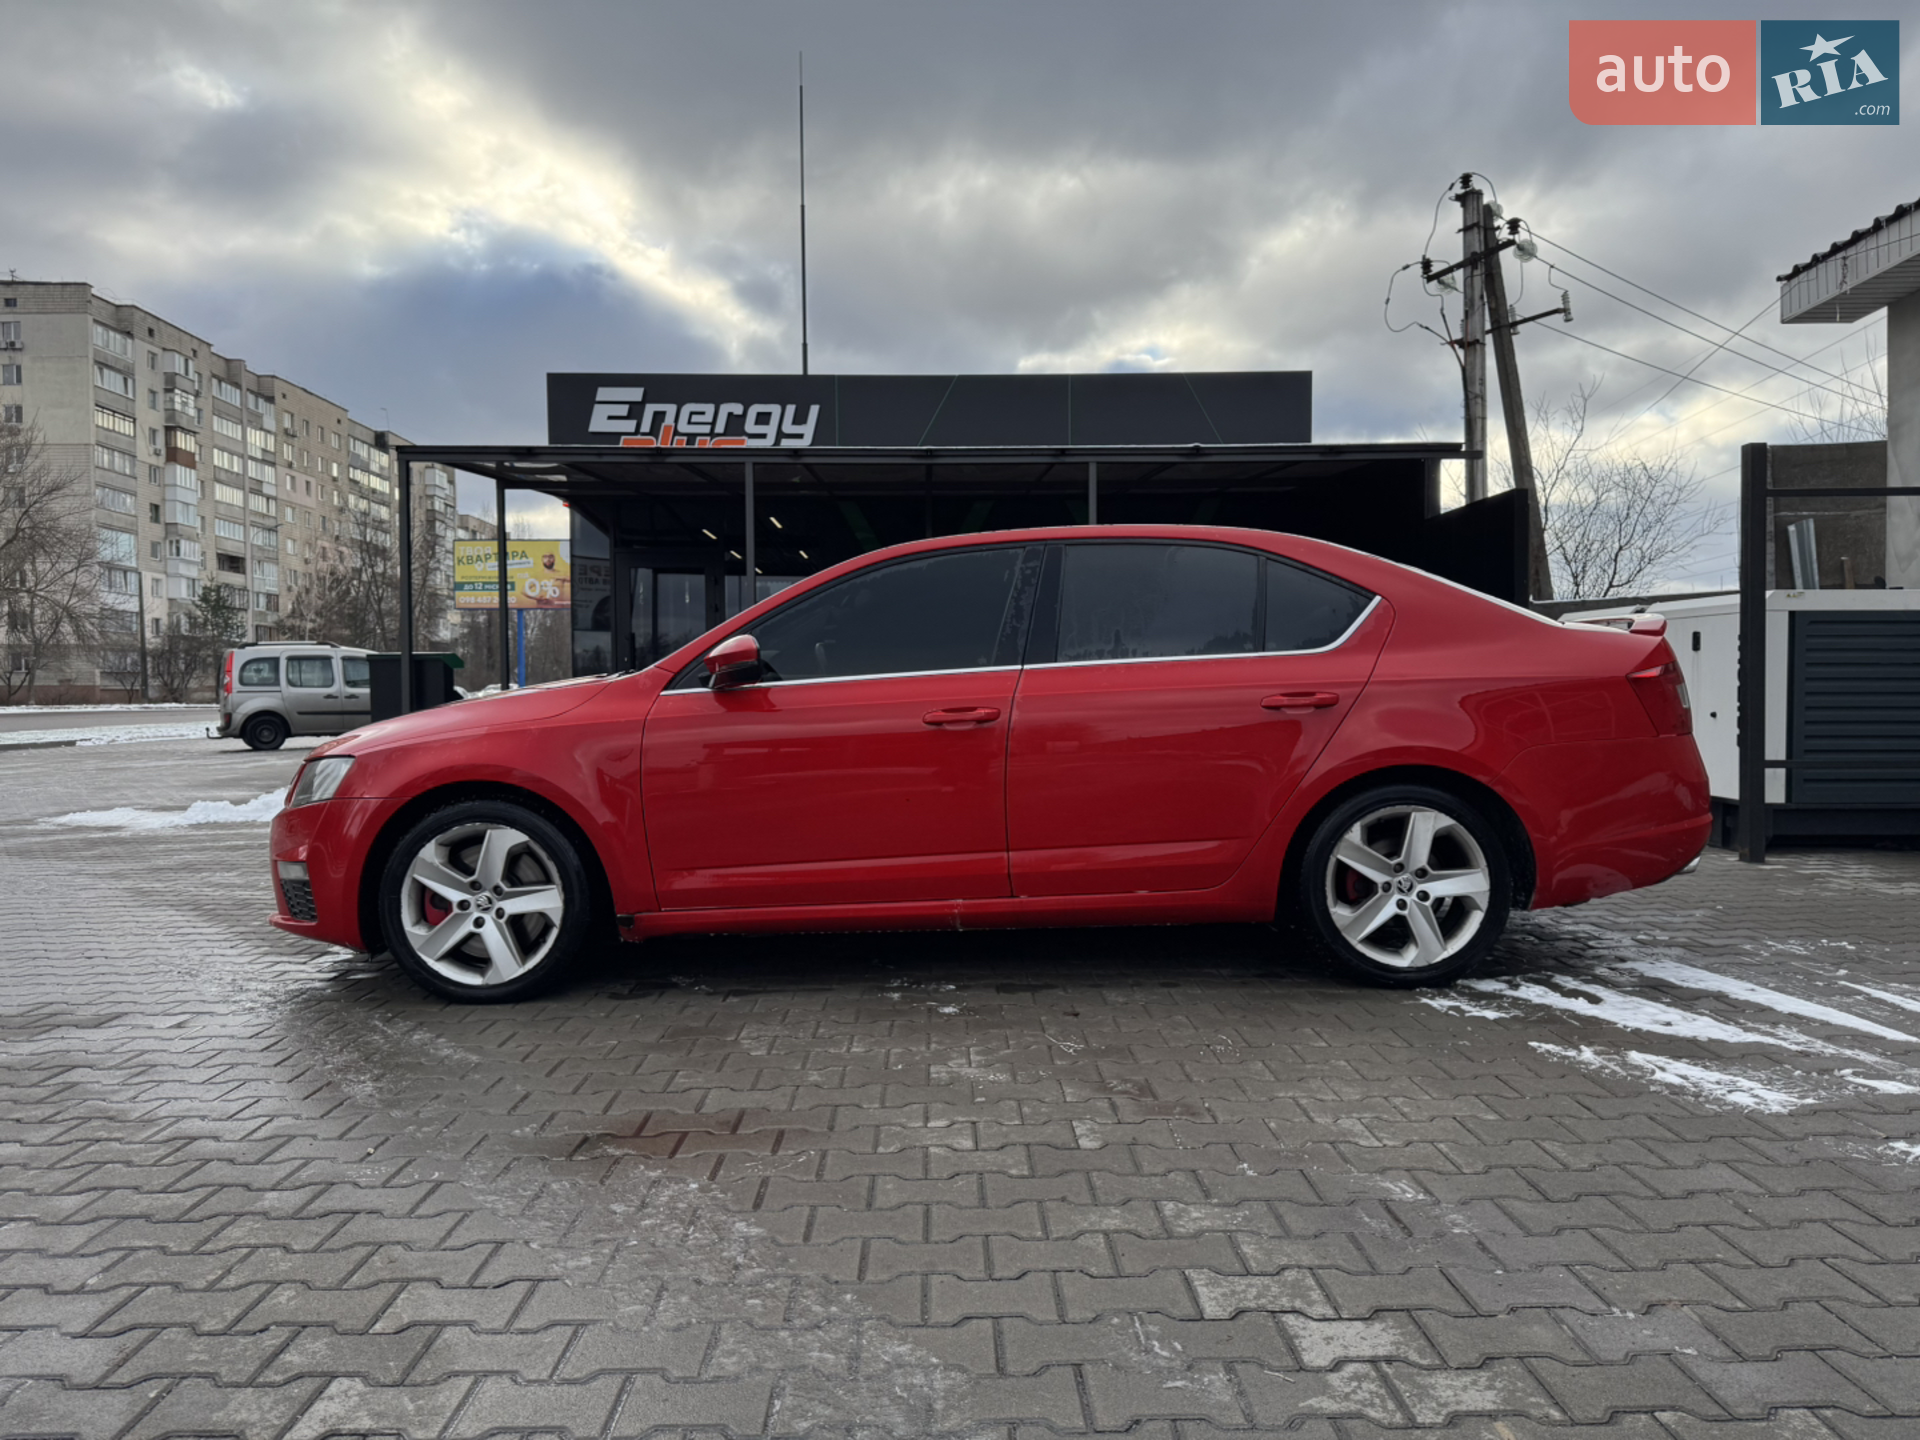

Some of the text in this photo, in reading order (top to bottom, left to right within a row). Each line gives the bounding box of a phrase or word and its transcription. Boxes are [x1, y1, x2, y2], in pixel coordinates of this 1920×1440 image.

[588, 387, 820, 446] Energy
[459, 546, 492, 555] ТВОЯ
[474, 582, 484, 590] 12
[525, 578, 560, 599] 0%
